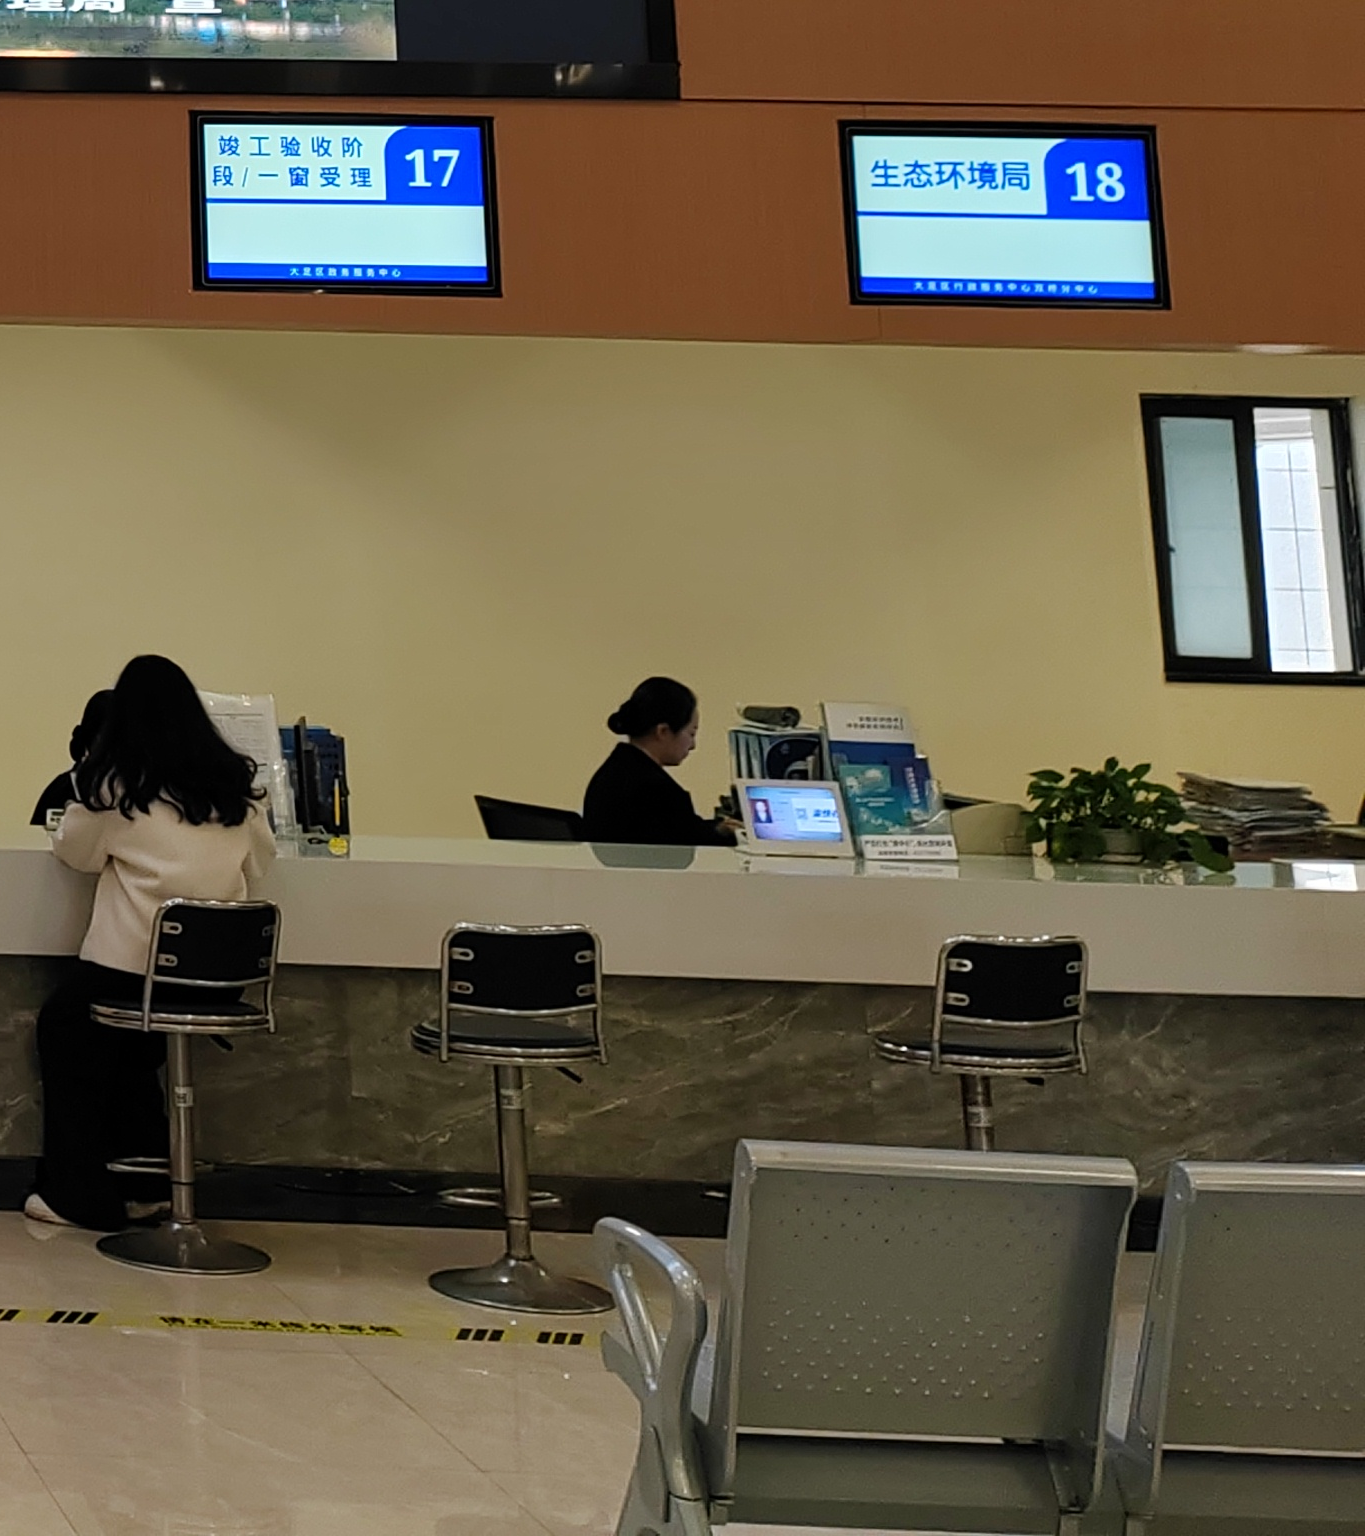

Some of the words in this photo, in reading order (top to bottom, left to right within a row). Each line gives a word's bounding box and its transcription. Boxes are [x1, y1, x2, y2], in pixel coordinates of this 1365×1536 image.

[218, 135, 365, 158] 竣工验收阶
[212, 165, 373, 188] 段/一窗受理
[404, 149, 461, 187] 17
[869, 159, 1031, 191] 生态环境局
[1065, 161, 1126, 202] 18
